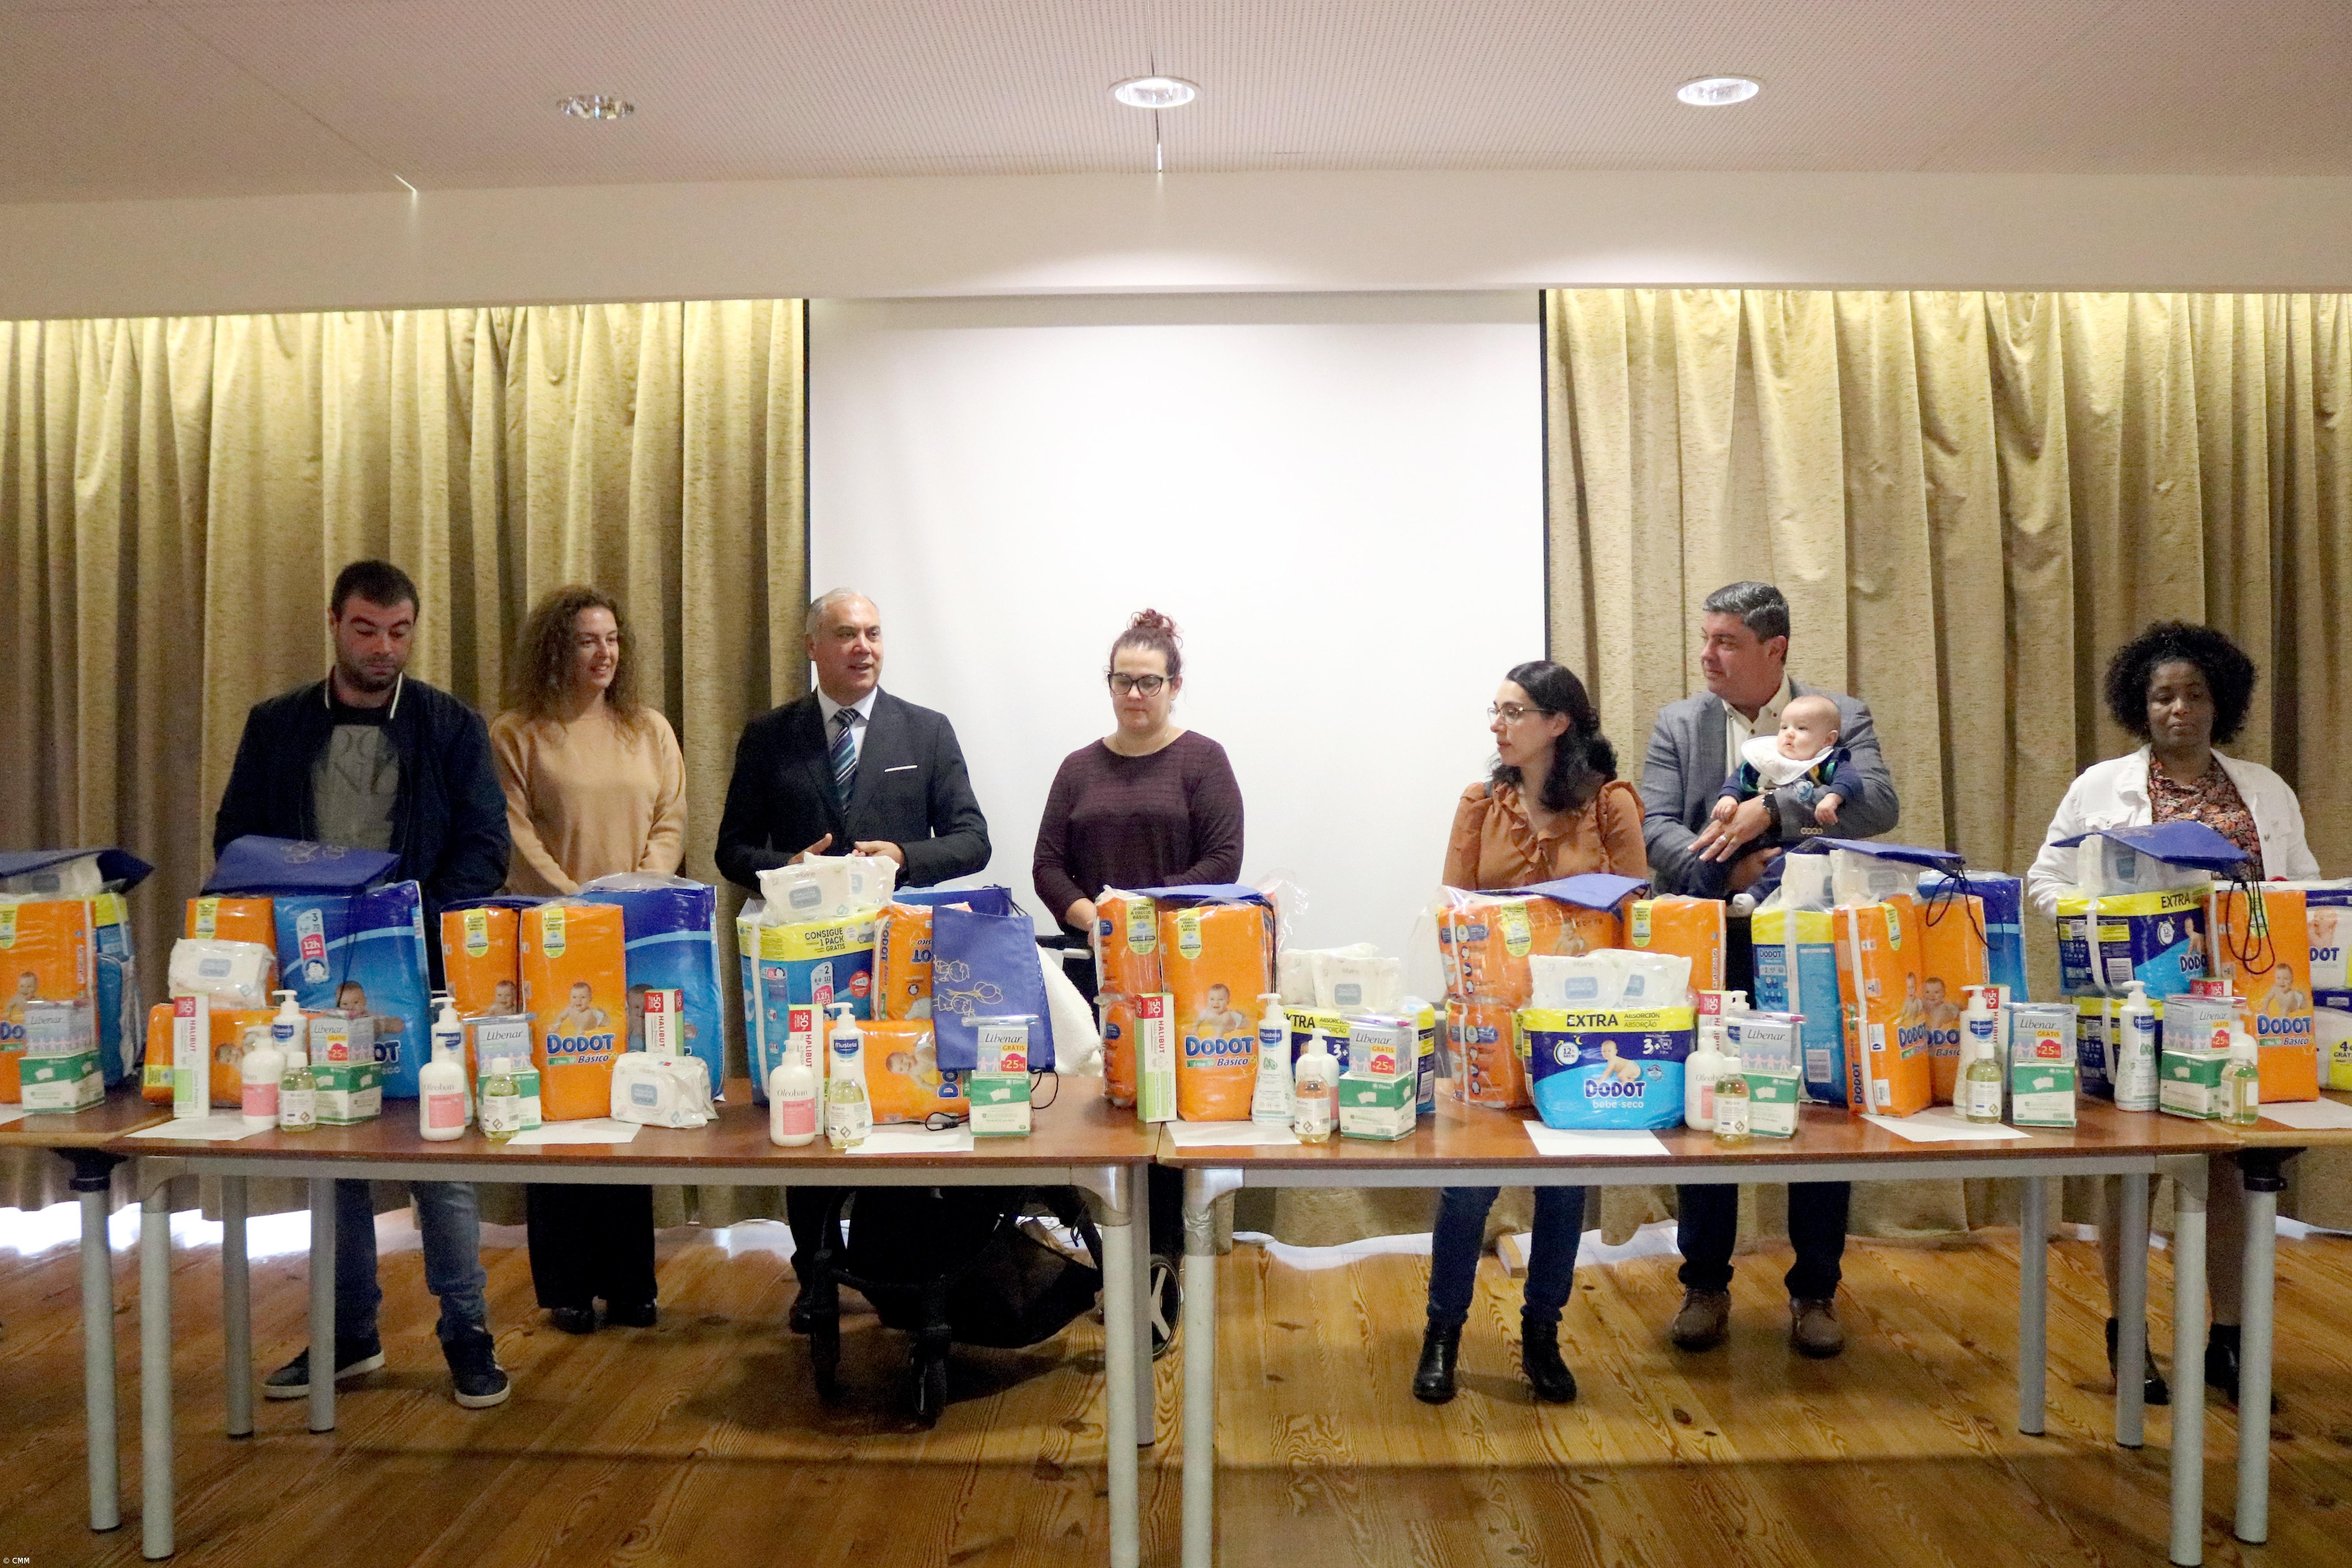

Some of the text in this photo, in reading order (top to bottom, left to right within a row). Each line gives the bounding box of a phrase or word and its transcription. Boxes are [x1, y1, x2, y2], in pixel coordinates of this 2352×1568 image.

[2161, 892, 2190, 909] EXTRA
[805, 927, 843, 940] CONSIGUE
[304, 941, 321, 949] 12h
[826, 935, 844, 945] PACK
[881, 921, 891, 961] DODOT
[826, 943, 846, 952] GRATIS
[2310, 947, 2339, 961] DOT
[824, 965, 829, 974] 2
[2180, 955, 2207, 973] DODO
[817, 991, 830, 1000] 12h
[1284, 1013, 1315, 1028] XTRA
[1566, 1014, 1618, 1027] EXTRA
[2020, 1019, 2057, 1029] Libenar
[2258, 1015, 2311, 1034] DODOT
[315, 1025, 343, 1033] Libenar
[1748, 1029, 1786, 1040] Libenar
[486, 1031, 523, 1041] Libenar
[985, 1033, 1022, 1043] Libenar
[1356, 1033, 1391, 1044] Libenar
[2284, 1037, 2308, 1045] Básico
[547, 1034, 615, 1054] DODOT
[1185, 1036, 1254, 1056] DODOT
[2339, 1041, 2348, 1051] 4
[578, 1053, 609, 1063] Básico
[1217, 1057, 1249, 1066] Básico
[1003, 1060, 1025, 1069] +25%
[1372, 1060, 1394, 1071] +25%
[1584, 1079, 1646, 1098] DODOT
[1852, 1062, 1863, 1104] DODOT
